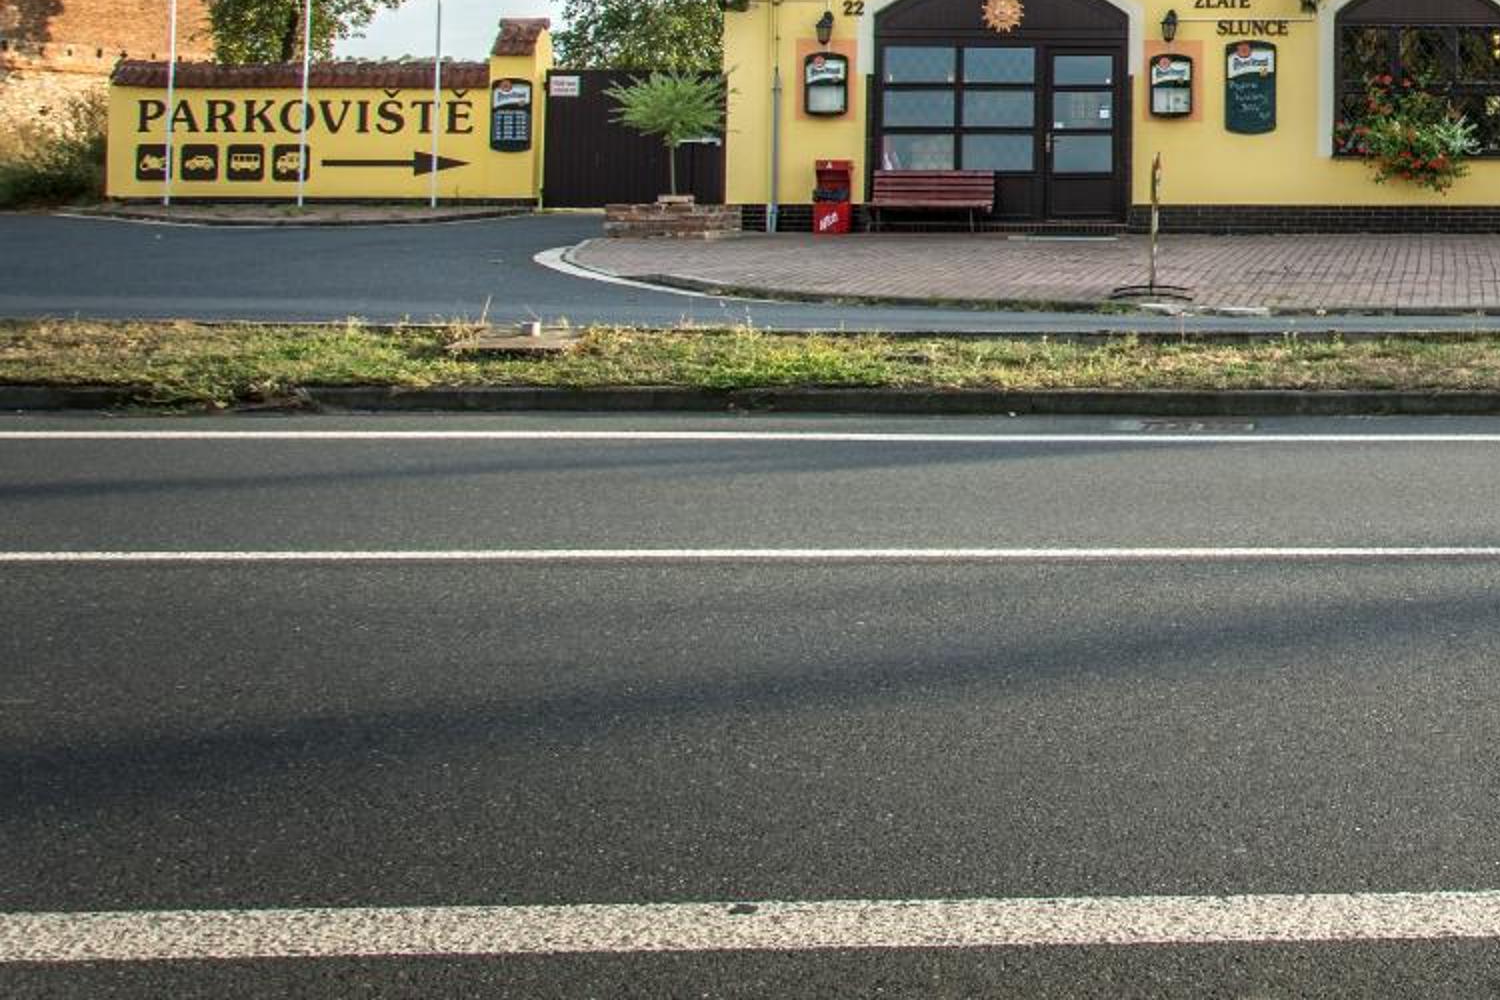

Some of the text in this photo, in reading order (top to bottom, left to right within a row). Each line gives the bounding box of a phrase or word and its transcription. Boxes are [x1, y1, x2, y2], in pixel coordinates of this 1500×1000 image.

[842, 0, 865, 17] 22
[1216, 19, 1289, 37] SLUNCE
[137, 89, 475, 134] PARKOVIŠTĚ
